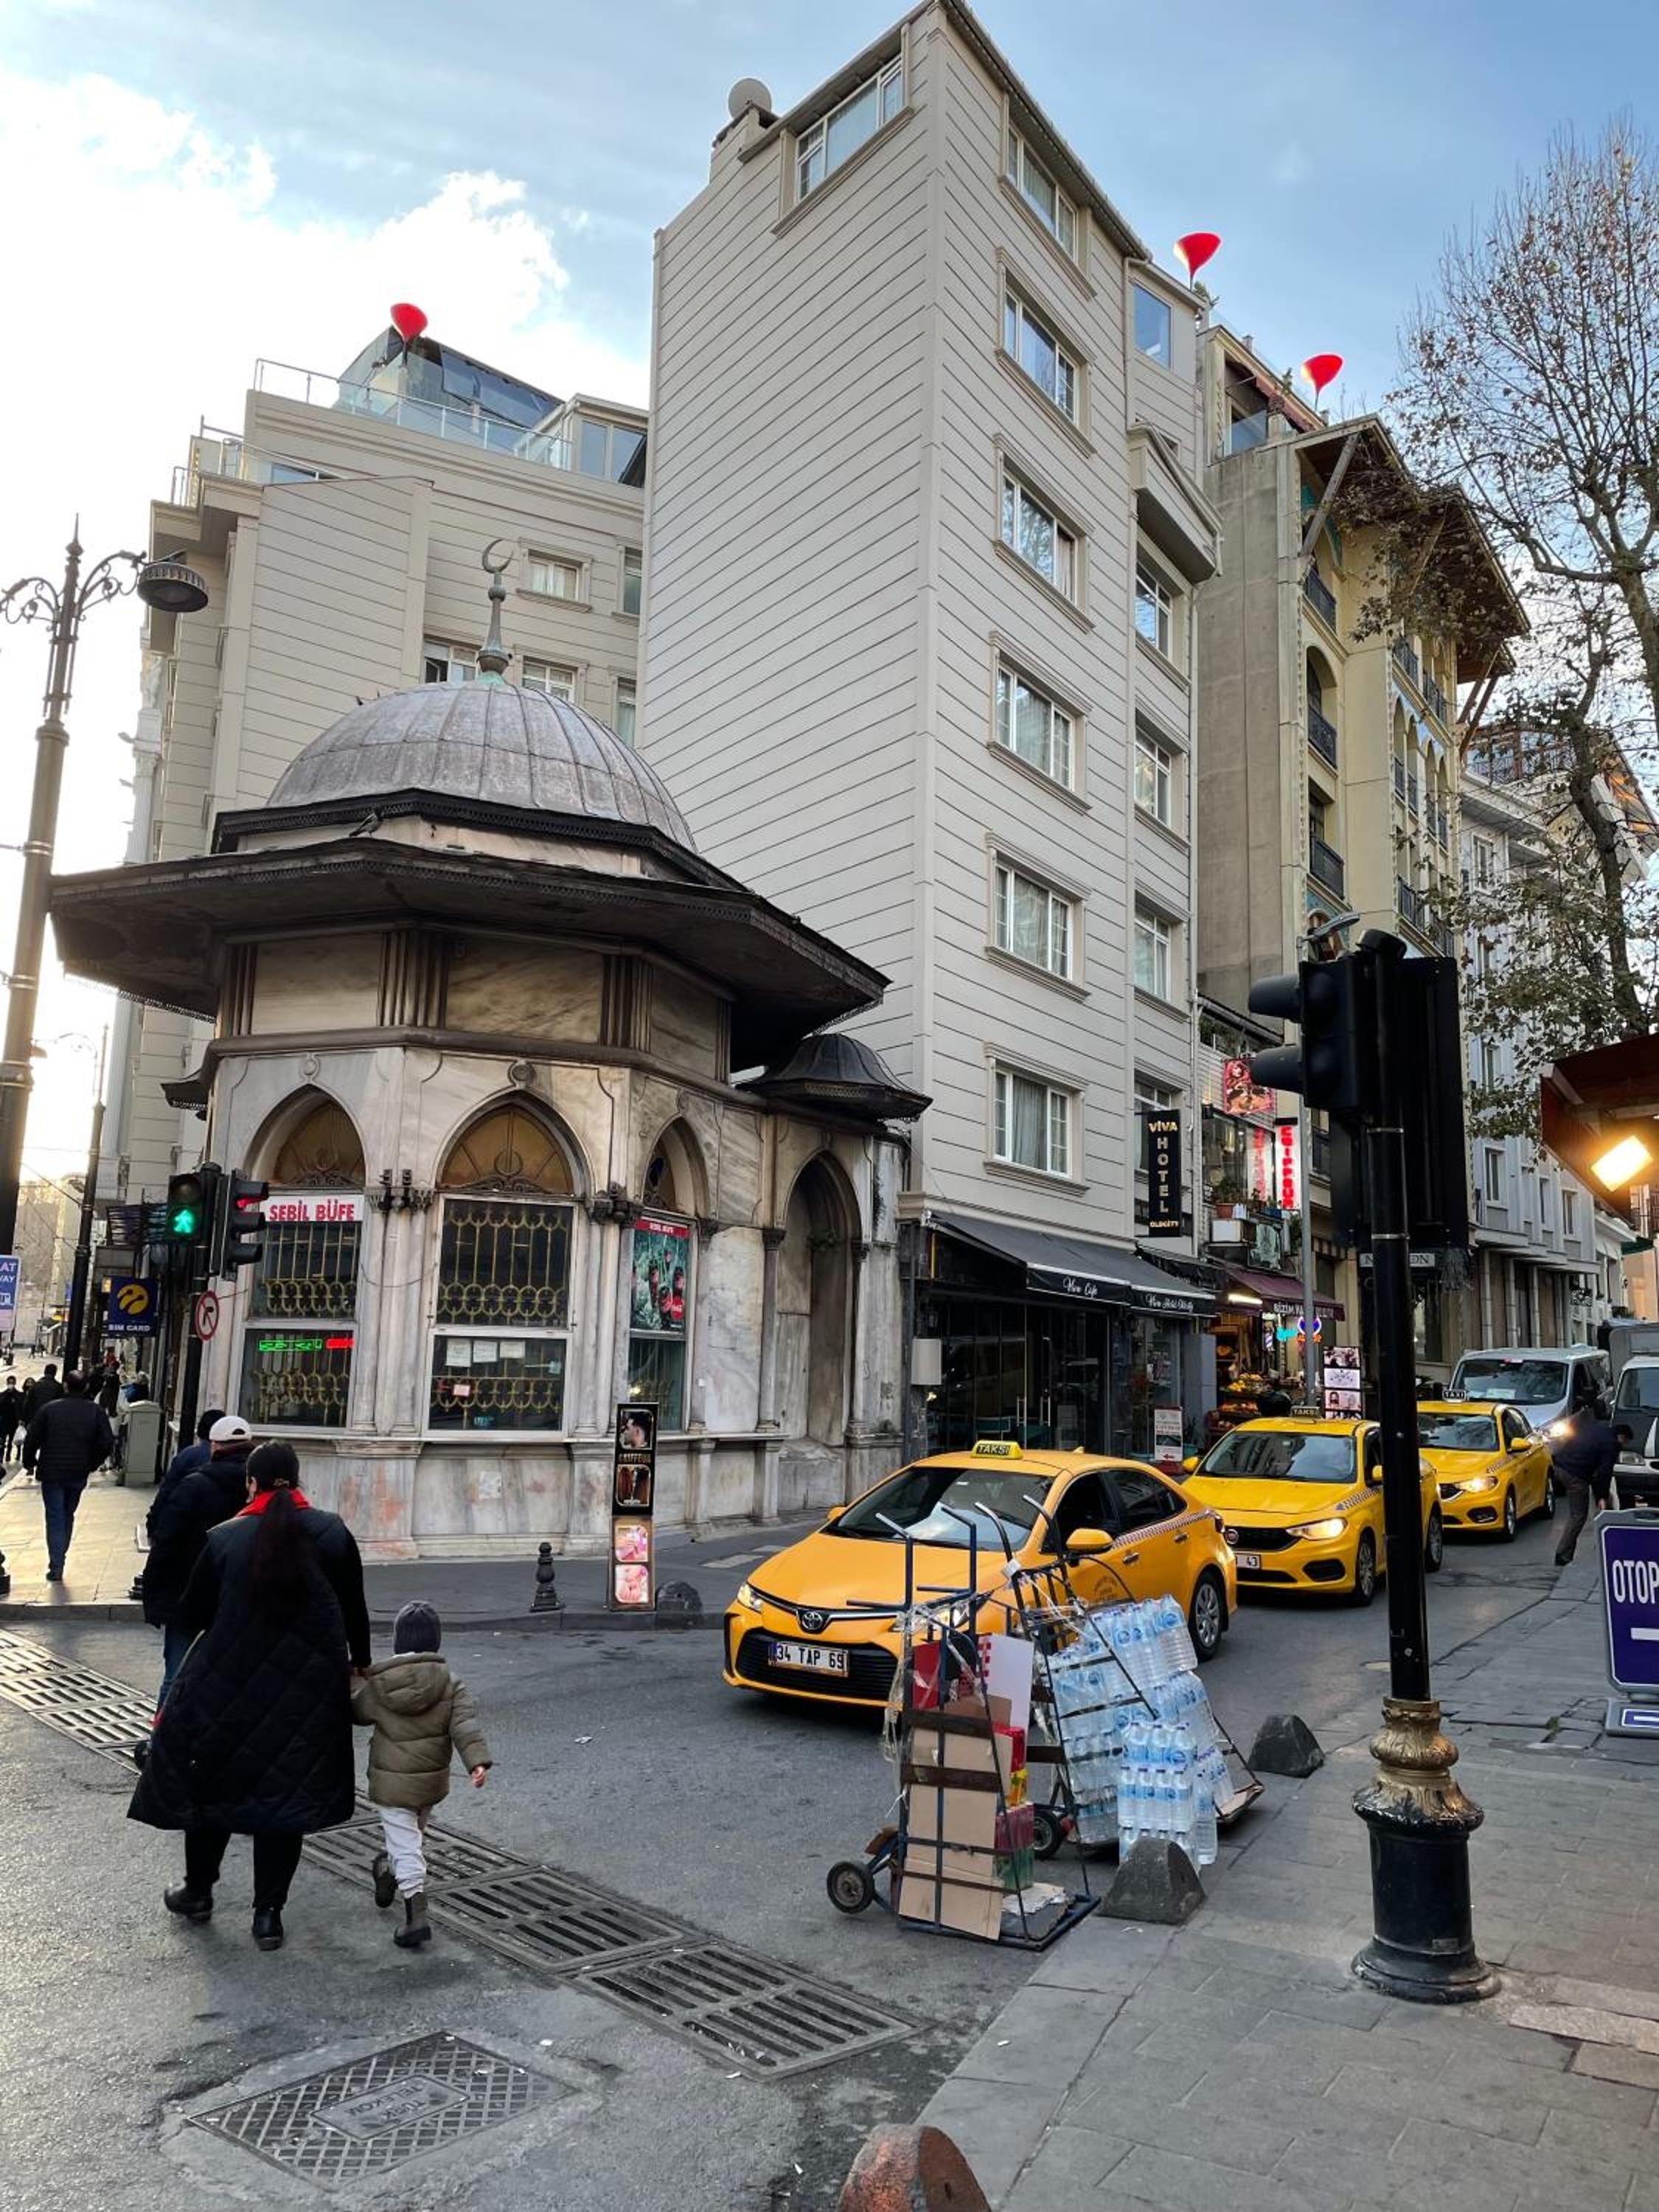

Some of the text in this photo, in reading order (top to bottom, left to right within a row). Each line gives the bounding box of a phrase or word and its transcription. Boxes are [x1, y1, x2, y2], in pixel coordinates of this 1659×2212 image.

[1157, 1136, 1169, 1213] HOTEL
[270, 1198, 355, 1222] SEBİL BÜFE
[1444, 1391, 1464, 1399] TAXI
[1246, 1557, 1257, 1567] 43
[1613, 1559, 1659, 1604] OTOP
[776, 1645, 844, 1670] 34 TAP 69
